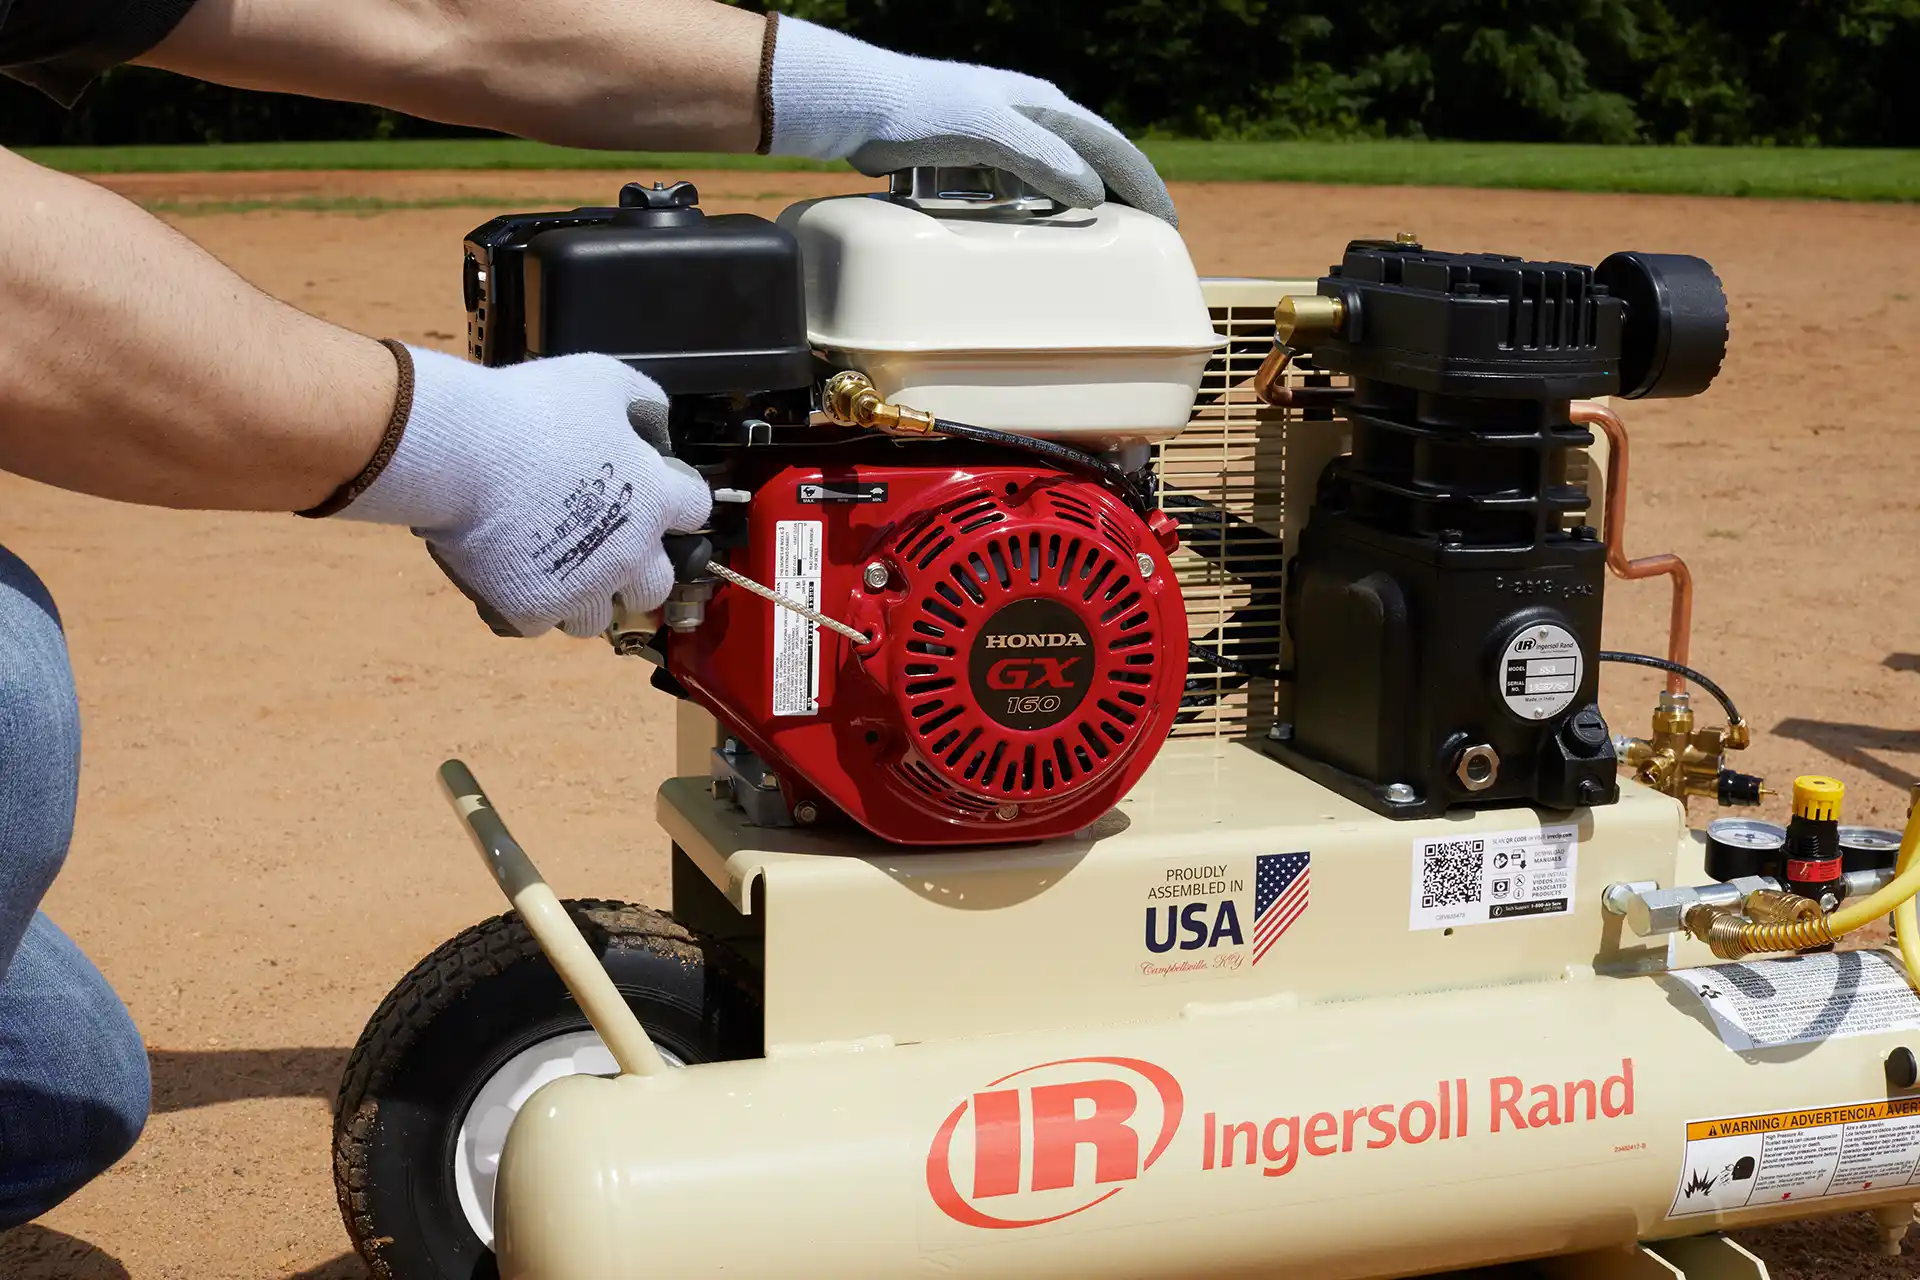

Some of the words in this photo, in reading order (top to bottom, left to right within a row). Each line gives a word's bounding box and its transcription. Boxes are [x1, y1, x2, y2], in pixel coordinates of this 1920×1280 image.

[985, 633, 1087, 648] HONDA
[1536, 643, 1560, 651] Ingersoll
[986, 656, 1081, 690] GX
[1007, 695, 1061, 714] 160
[1166, 864, 1228, 882] PROUDLY
[1148, 880, 1226, 900] ASSEMBLED
[1230, 880, 1244, 892] IN
[1532, 883, 1567, 891] ASSOCIATED
[1145, 900, 1244, 954] USA
[1212, 952, 1246, 971] KY
[1720, 1118, 1780, 1134] WARNING
[1790, 1107, 1876, 1129] ADVERTENCIA
[1886, 1101, 1920, 1116] AVER
[972, 1079, 1139, 1199] IR
[1202, 1078, 1468, 1178] Ingersoll
[1489, 1057, 1635, 1134] Rand
